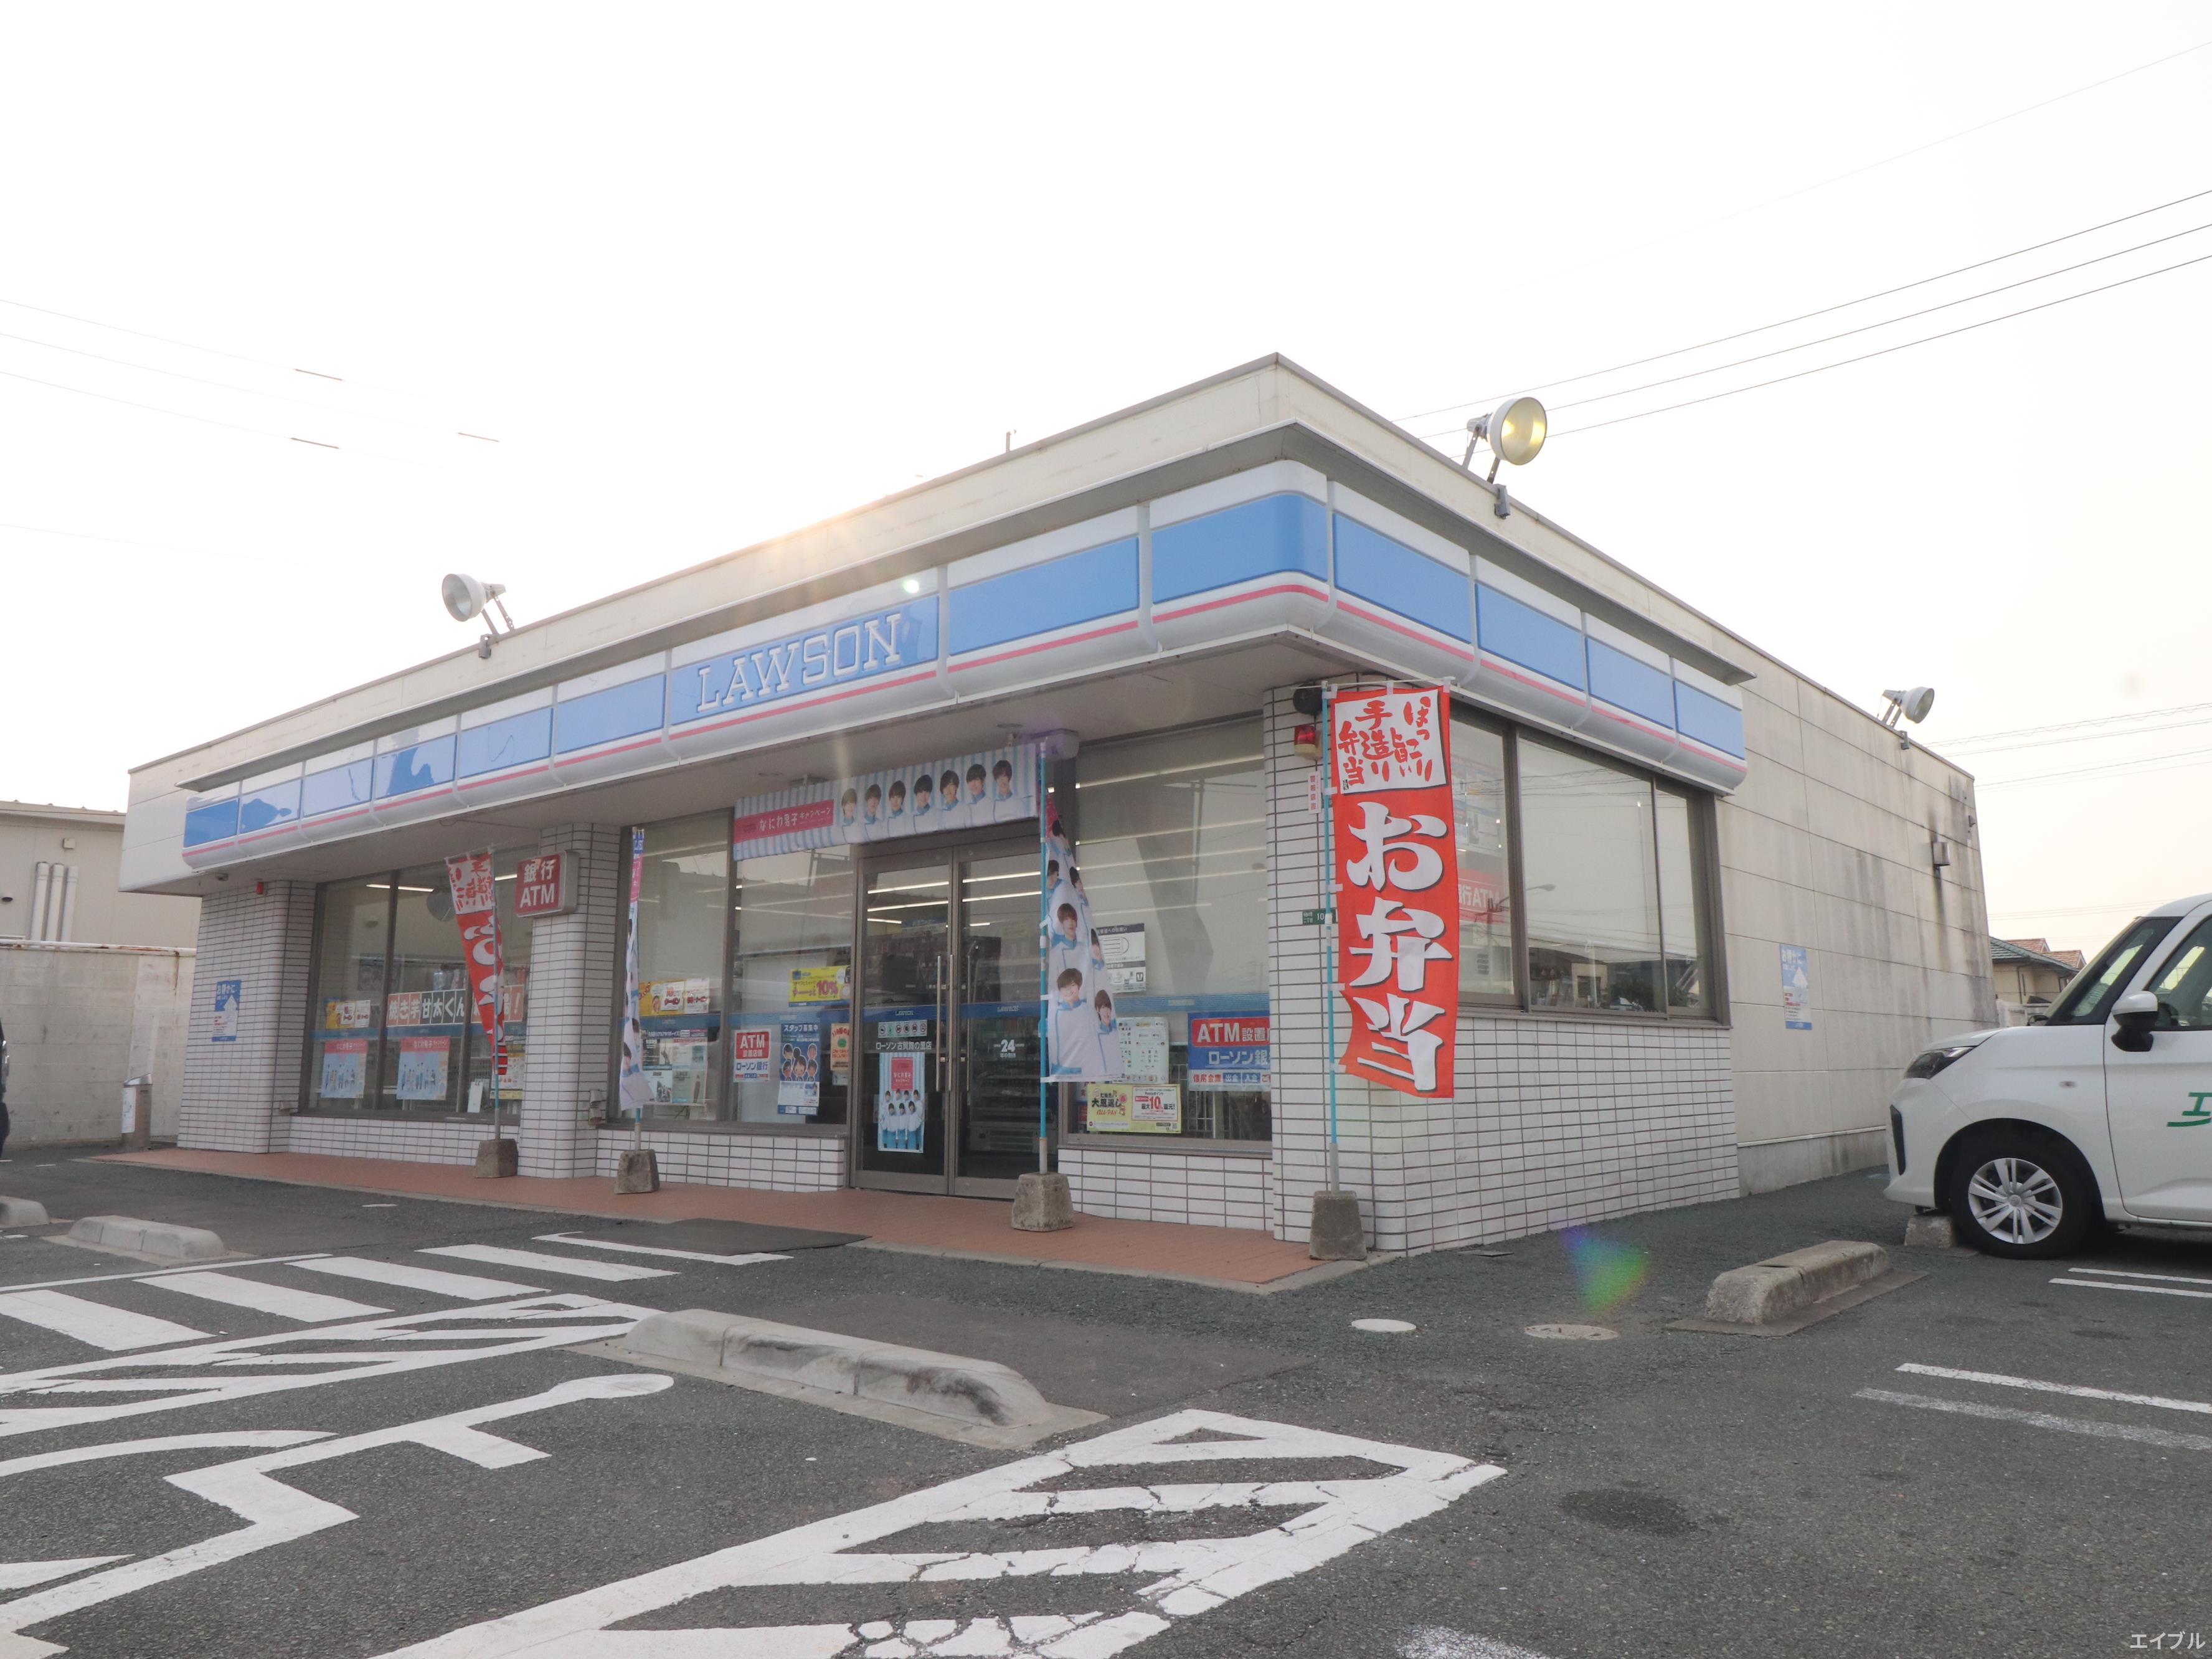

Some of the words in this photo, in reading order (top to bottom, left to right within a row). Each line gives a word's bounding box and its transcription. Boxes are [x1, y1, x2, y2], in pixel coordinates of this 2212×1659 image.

[696, 613, 902, 713] LAWSON
[1354, 699, 1395, 782] 手造り
[1403, 696, 1432, 782] ほっこり
[1338, 720, 1365, 787] 弁当
[759, 813, 798, 832] なにわ男子
[524, 858, 557, 884] 銀行
[519, 883, 555, 908] ATM
[1346, 801, 1453, 1091] お弁当
[740, 1034, 765, 1049] ATM
[1196, 1022, 1240, 1042] ATM
[1001, 1039, 1016, 1052] 24
[1208, 1050, 1270, 1066] ローソン銀
[736, 1061, 768, 1071] ローソン銀行
